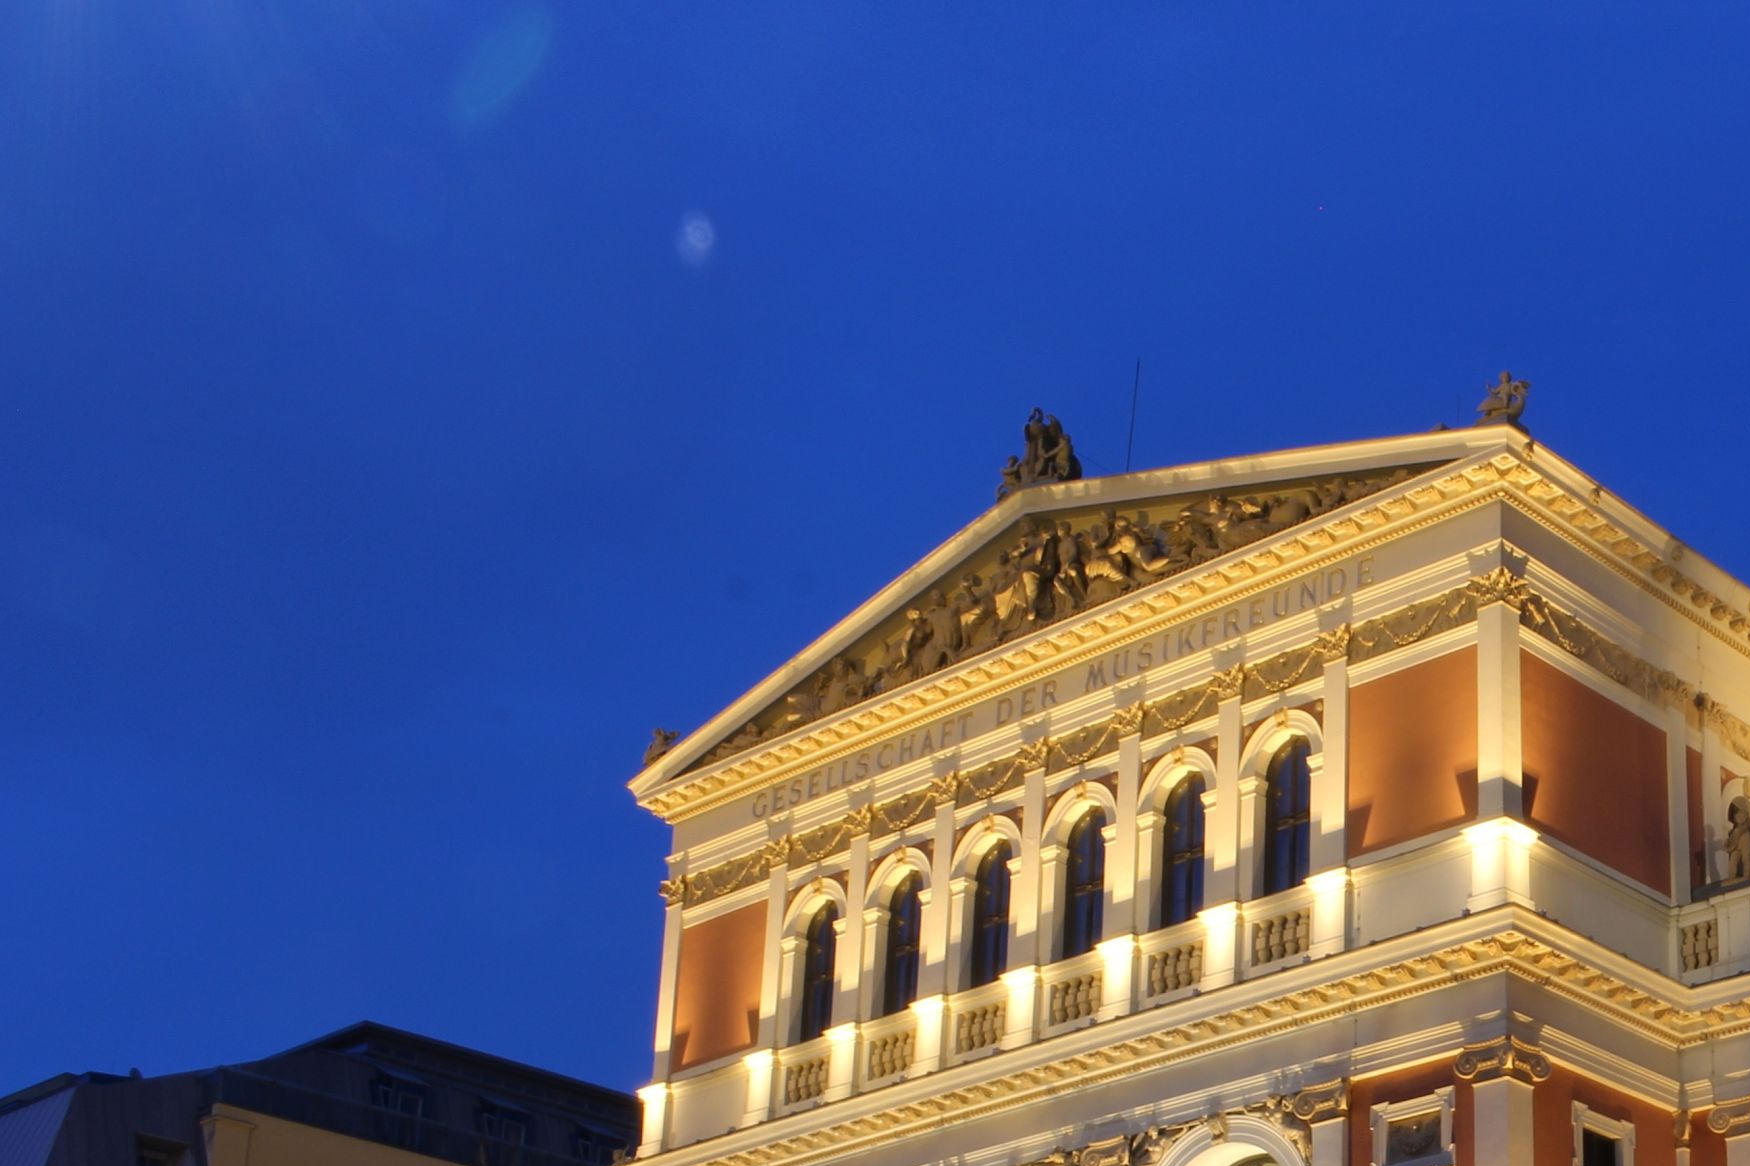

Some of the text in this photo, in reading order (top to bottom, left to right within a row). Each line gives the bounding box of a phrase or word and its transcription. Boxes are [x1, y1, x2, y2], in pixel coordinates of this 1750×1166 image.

[752, 555, 1375, 818] GESELLSCHAFT DER MUSIKFREUNDE
